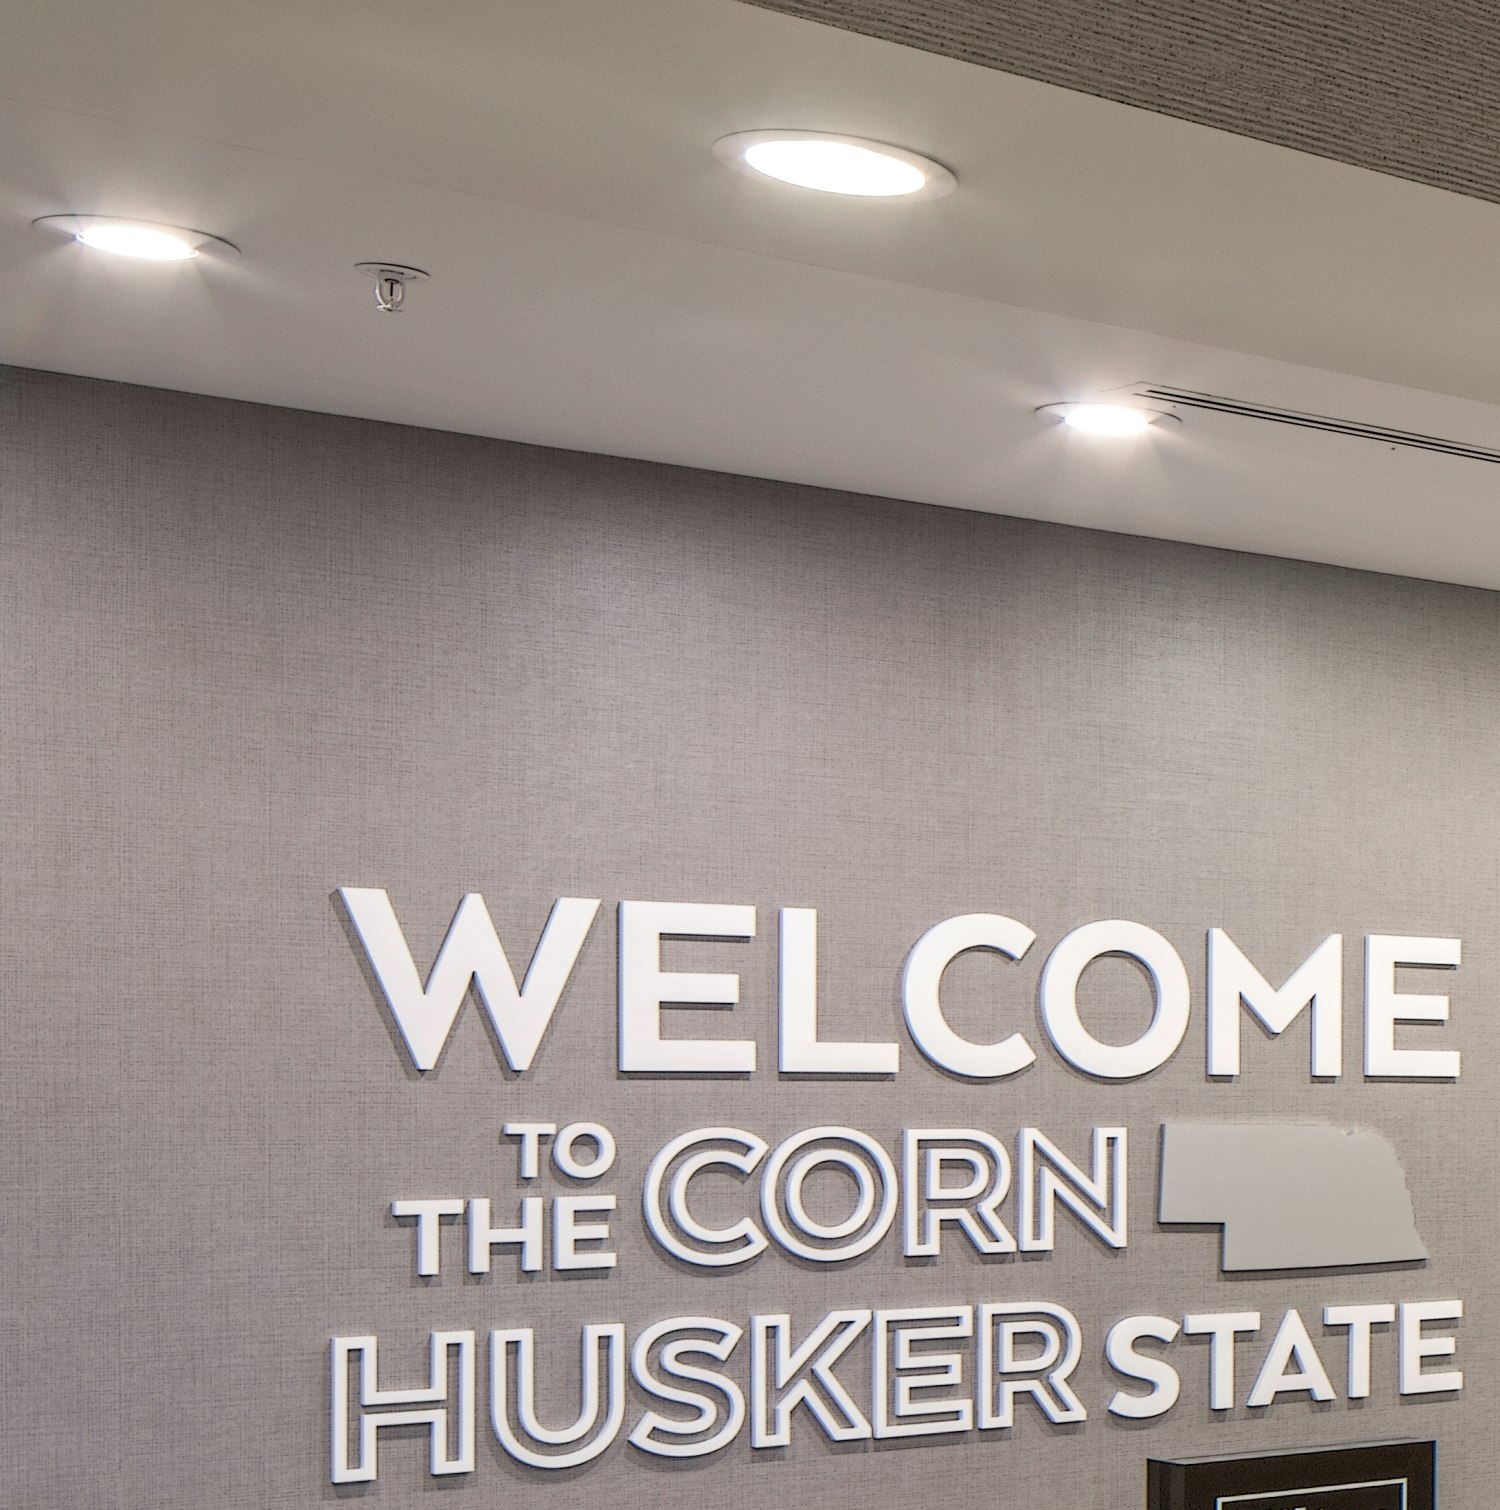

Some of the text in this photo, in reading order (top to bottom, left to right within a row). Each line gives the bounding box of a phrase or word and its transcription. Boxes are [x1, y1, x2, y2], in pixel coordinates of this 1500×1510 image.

[335, 885, 1464, 1080] WELCOME
[503, 1121, 618, 1181] TO
[642, 1125, 1131, 1268] CORN
[391, 1193, 620, 1277] THE
[330, 1300, 1088, 1485] HUSKER
[1107, 1299, 1465, 1420] STATE
